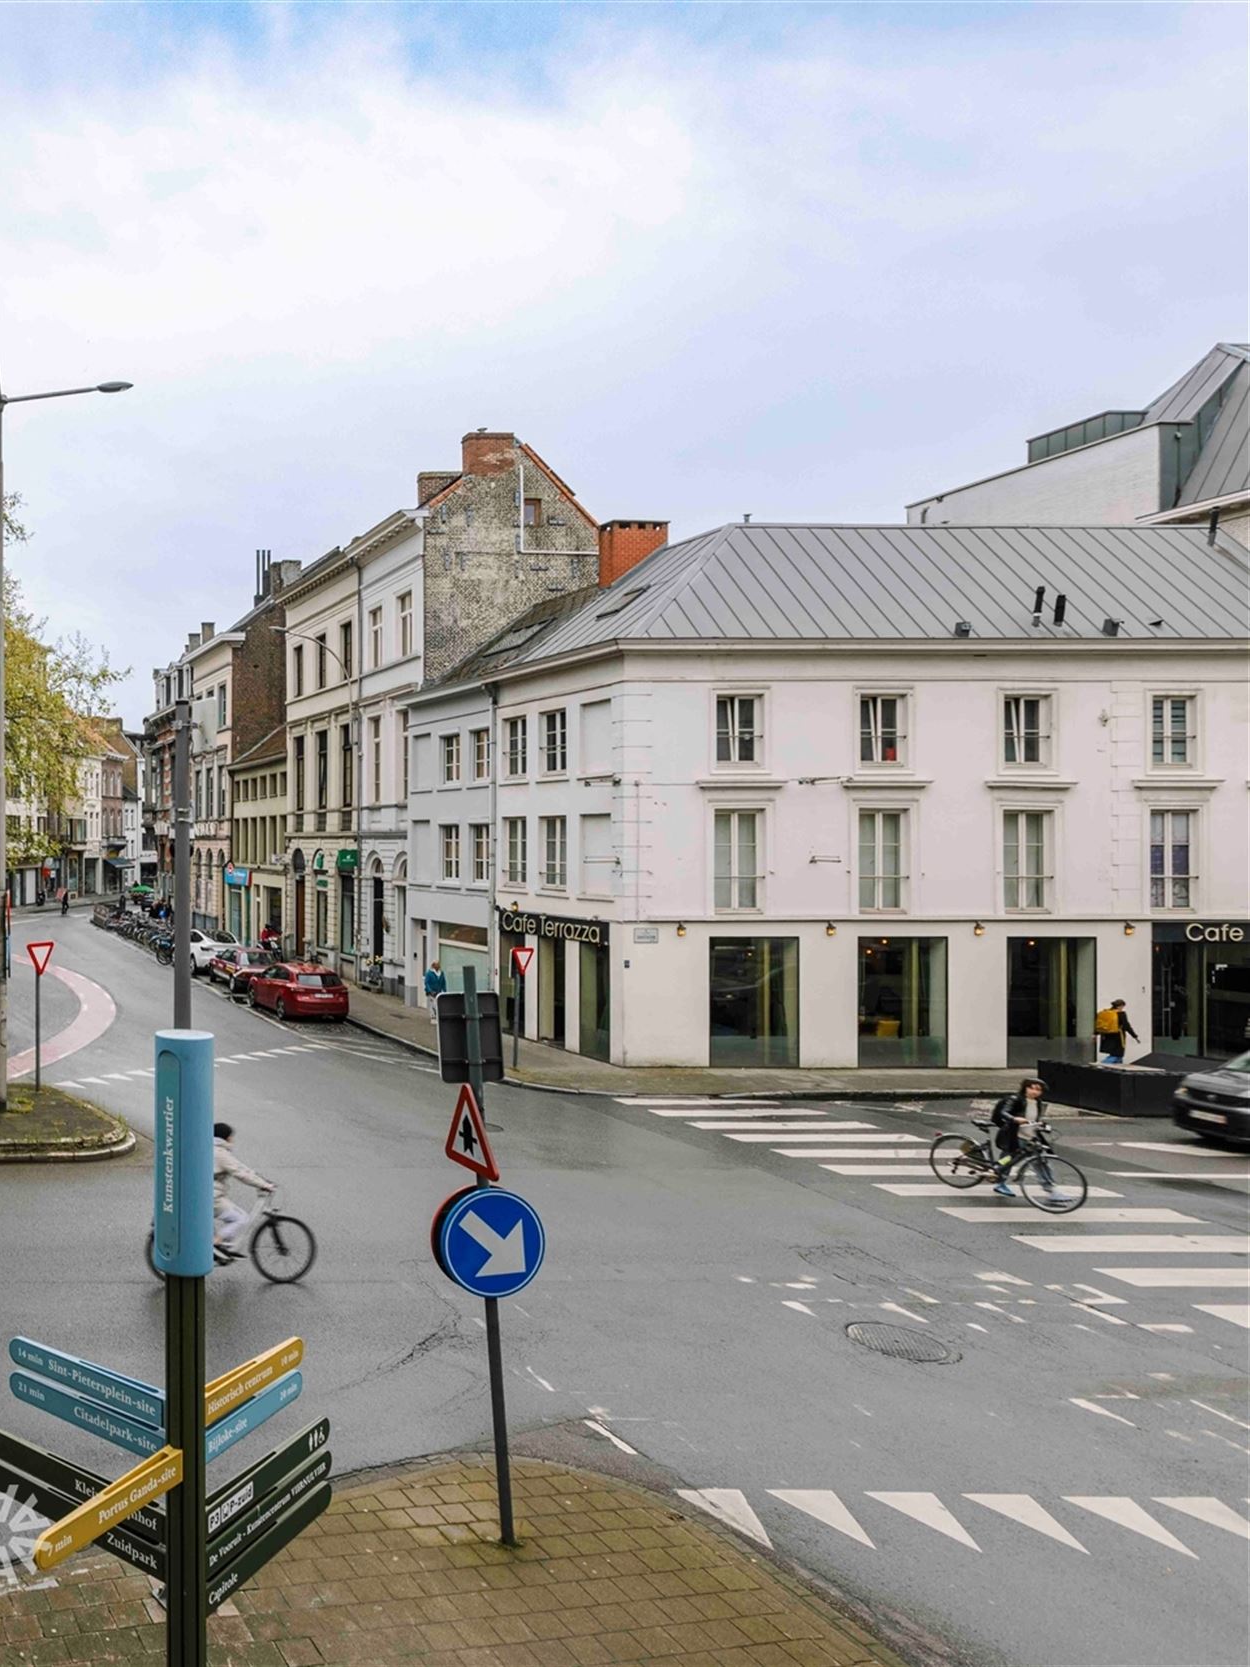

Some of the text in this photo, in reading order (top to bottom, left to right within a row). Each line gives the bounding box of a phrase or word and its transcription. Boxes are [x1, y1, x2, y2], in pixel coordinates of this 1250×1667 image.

[502, 912, 600, 943] Cafe Terrazza
[1186, 923, 1244, 942] Cafe
[163, 1096, 174, 1213] Kunstenkwartier
[17, 1347, 43, 1366] 14 min
[29, 1387, 45, 1402] min
[48, 1359, 156, 1417] Sint-Pietersplein-site
[207, 1366, 273, 1416] Historisch centrum
[74, 1406, 157, 1452] Citadelpark-site
[75, 1479, 96, 1498] Klei
[99, 1466, 176, 1525] Portus Ganda-site
[55, 1535, 72, 1552] min
[107, 1532, 158, 1570] Zuidpark
[209, 1554, 219, 1568] De
[219, 1532, 242, 1557] Vooruit
[208, 1572, 239, 1604] Capitole
